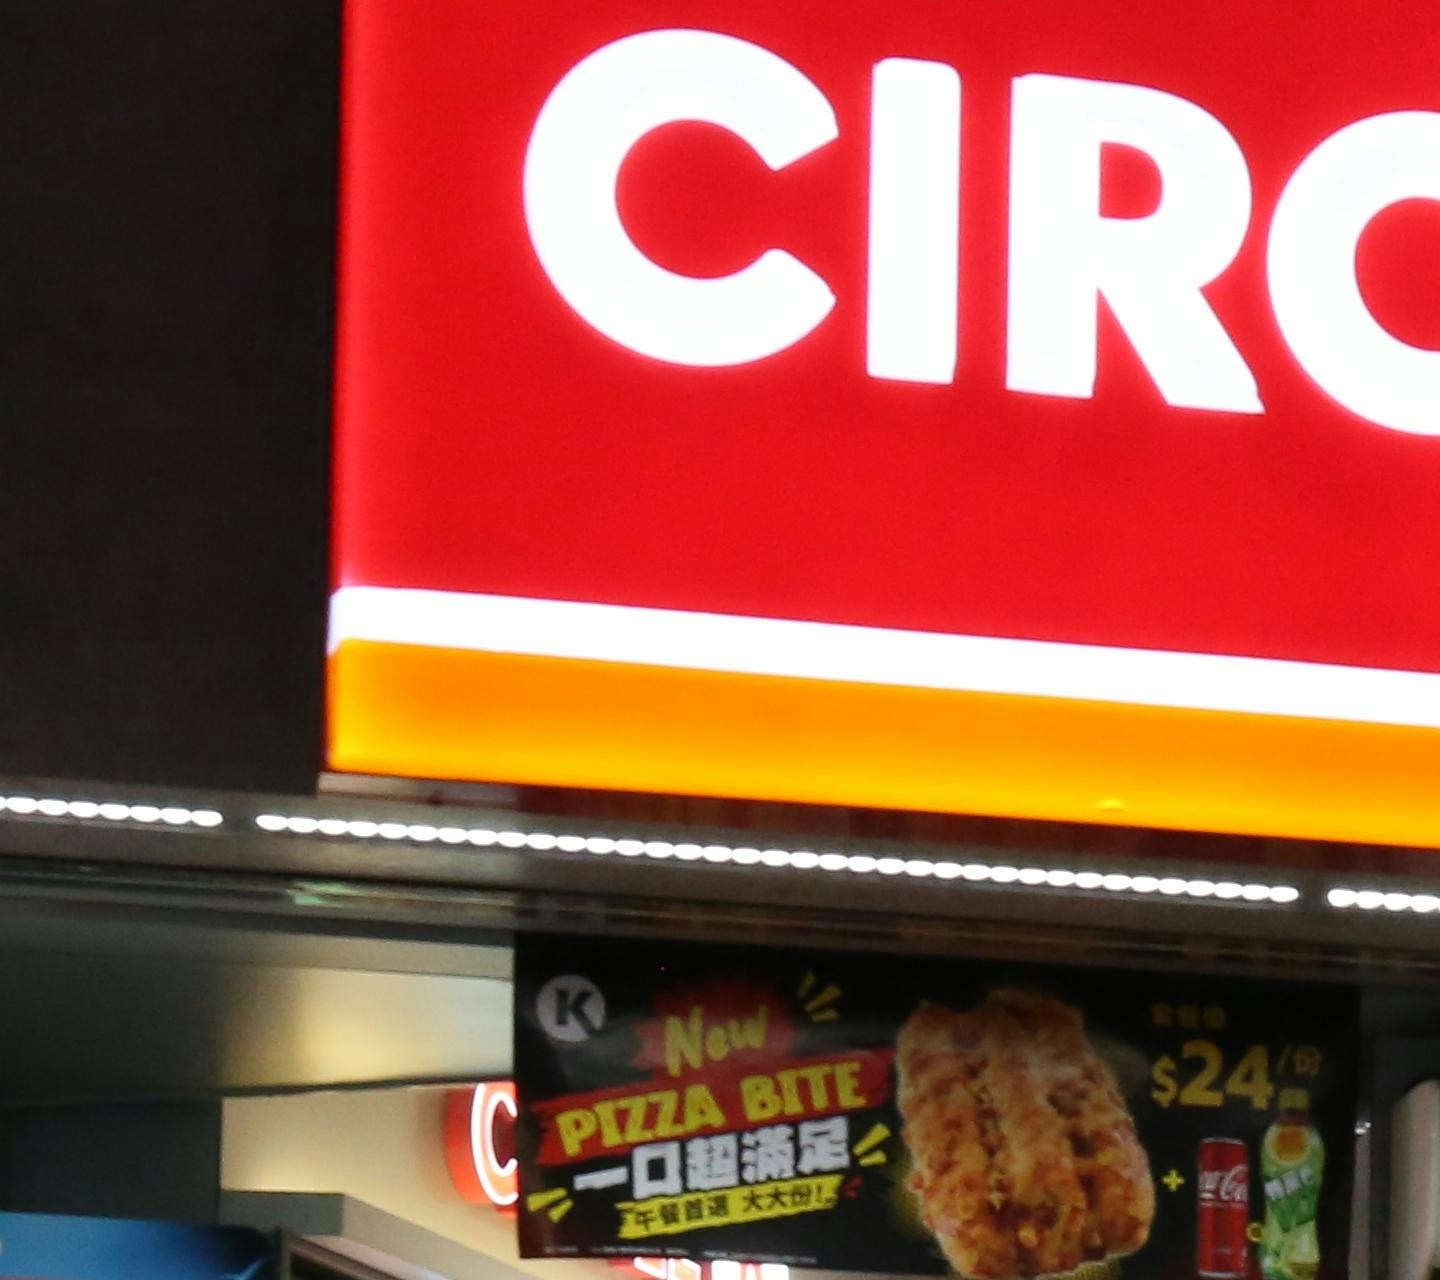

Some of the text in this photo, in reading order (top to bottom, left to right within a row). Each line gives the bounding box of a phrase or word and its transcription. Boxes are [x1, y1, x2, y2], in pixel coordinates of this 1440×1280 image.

[664, 1004, 768, 1077] New
[1151, 1039, 1275, 1110] $24
[556, 1084, 727, 1156] PIZZA
[739, 1062, 867, 1123] BITE
[573, 1115, 851, 1200] 一口超滿足
[633, 1190, 728, 1231] 午餐首選
